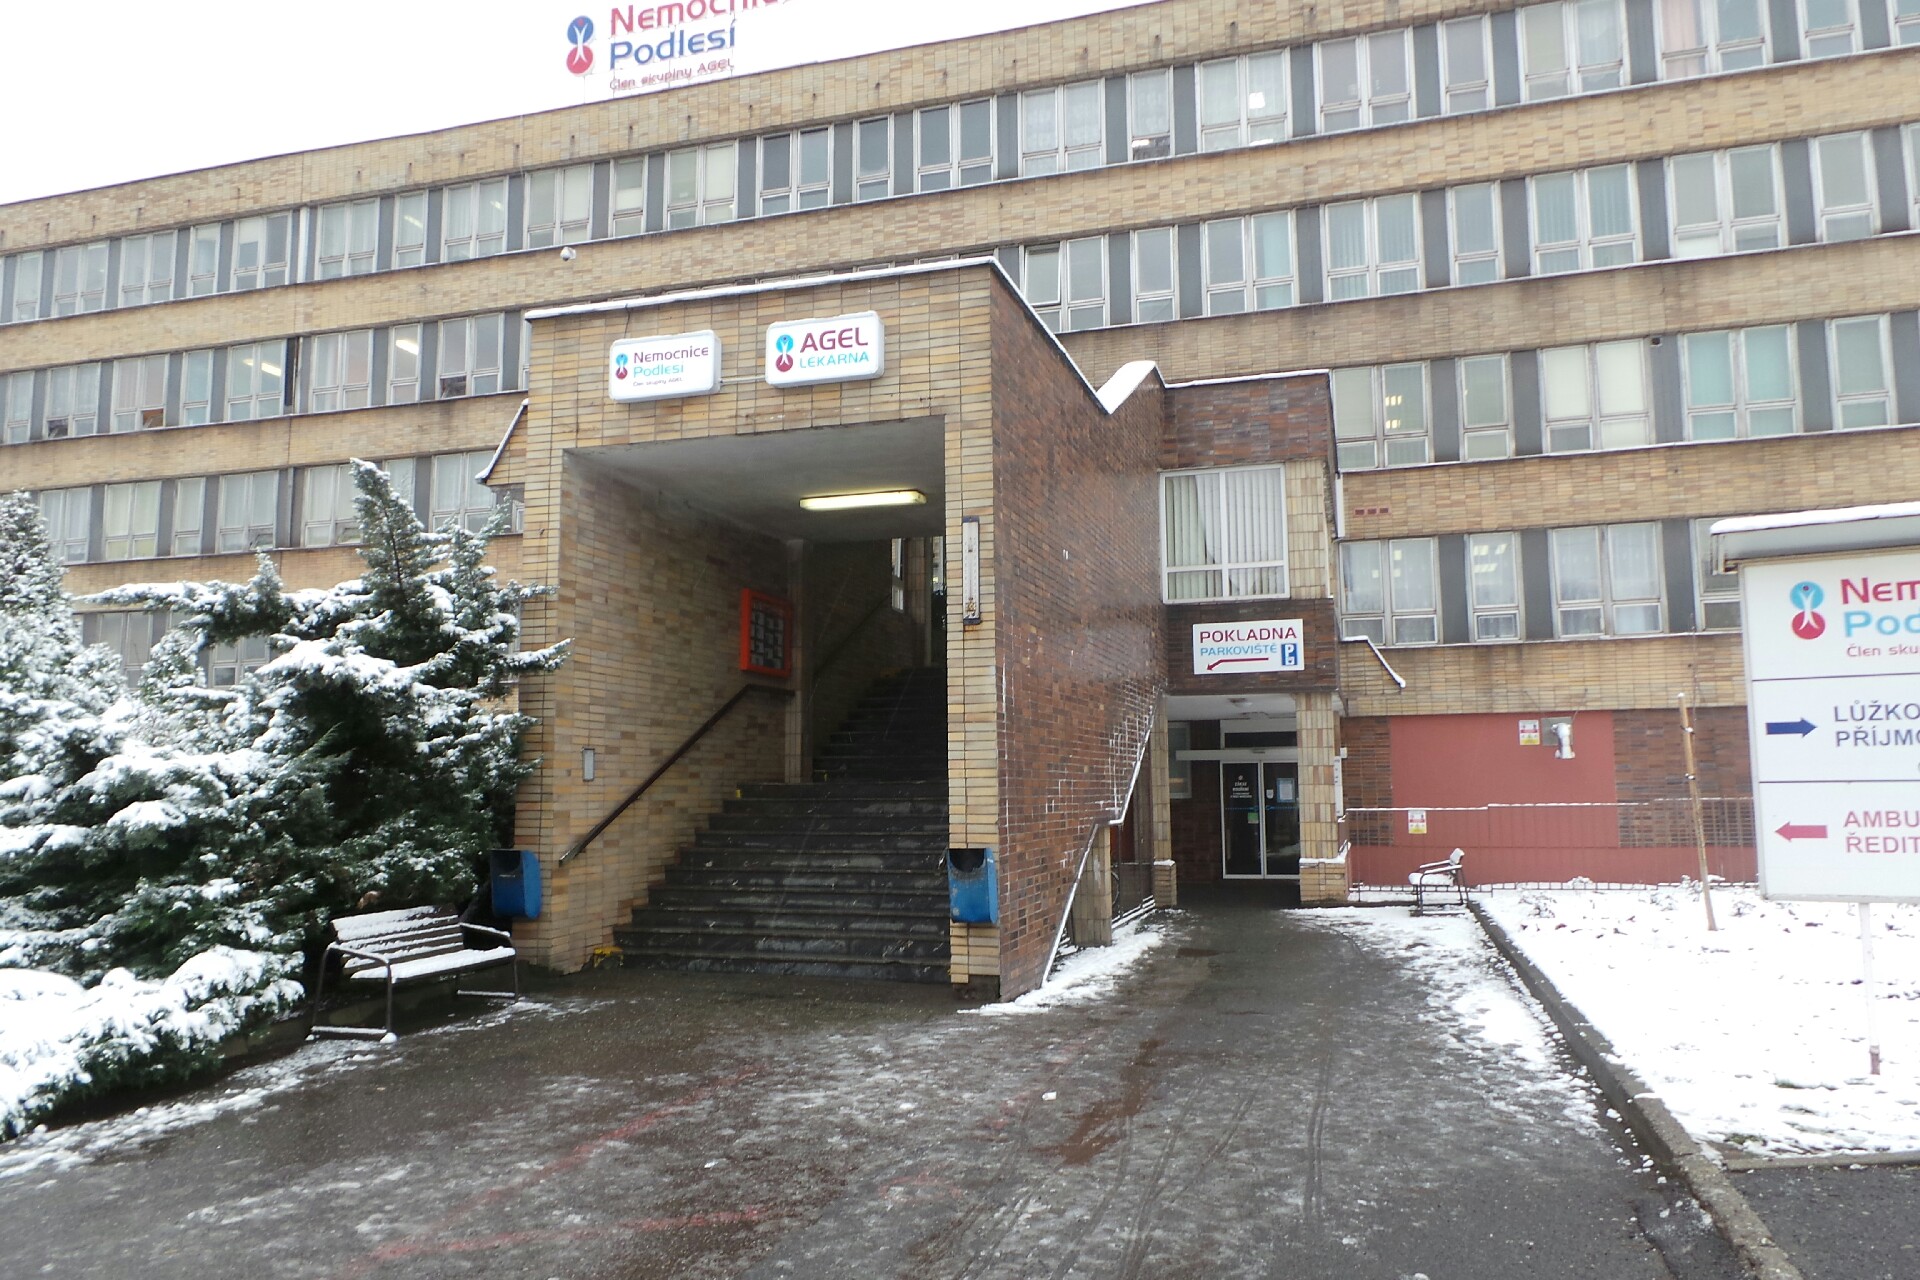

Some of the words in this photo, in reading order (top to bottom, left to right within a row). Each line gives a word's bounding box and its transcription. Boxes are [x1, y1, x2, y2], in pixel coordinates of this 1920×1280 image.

[609, 18, 735, 71] Podlesí
[697, 58, 734, 74] AGEL
[799, 326, 869, 353] AGEL
[633, 345, 709, 364] Nemocnice
[1200, 627, 1297, 643] POKLADNA
[1200, 643, 1277, 656] PARKOVIŠTĚ
[1846, 643, 1881, 658] Člen
[1834, 700, 1920, 722] LŮŽKO
[1836, 725, 1920, 748] PŘÍJM
